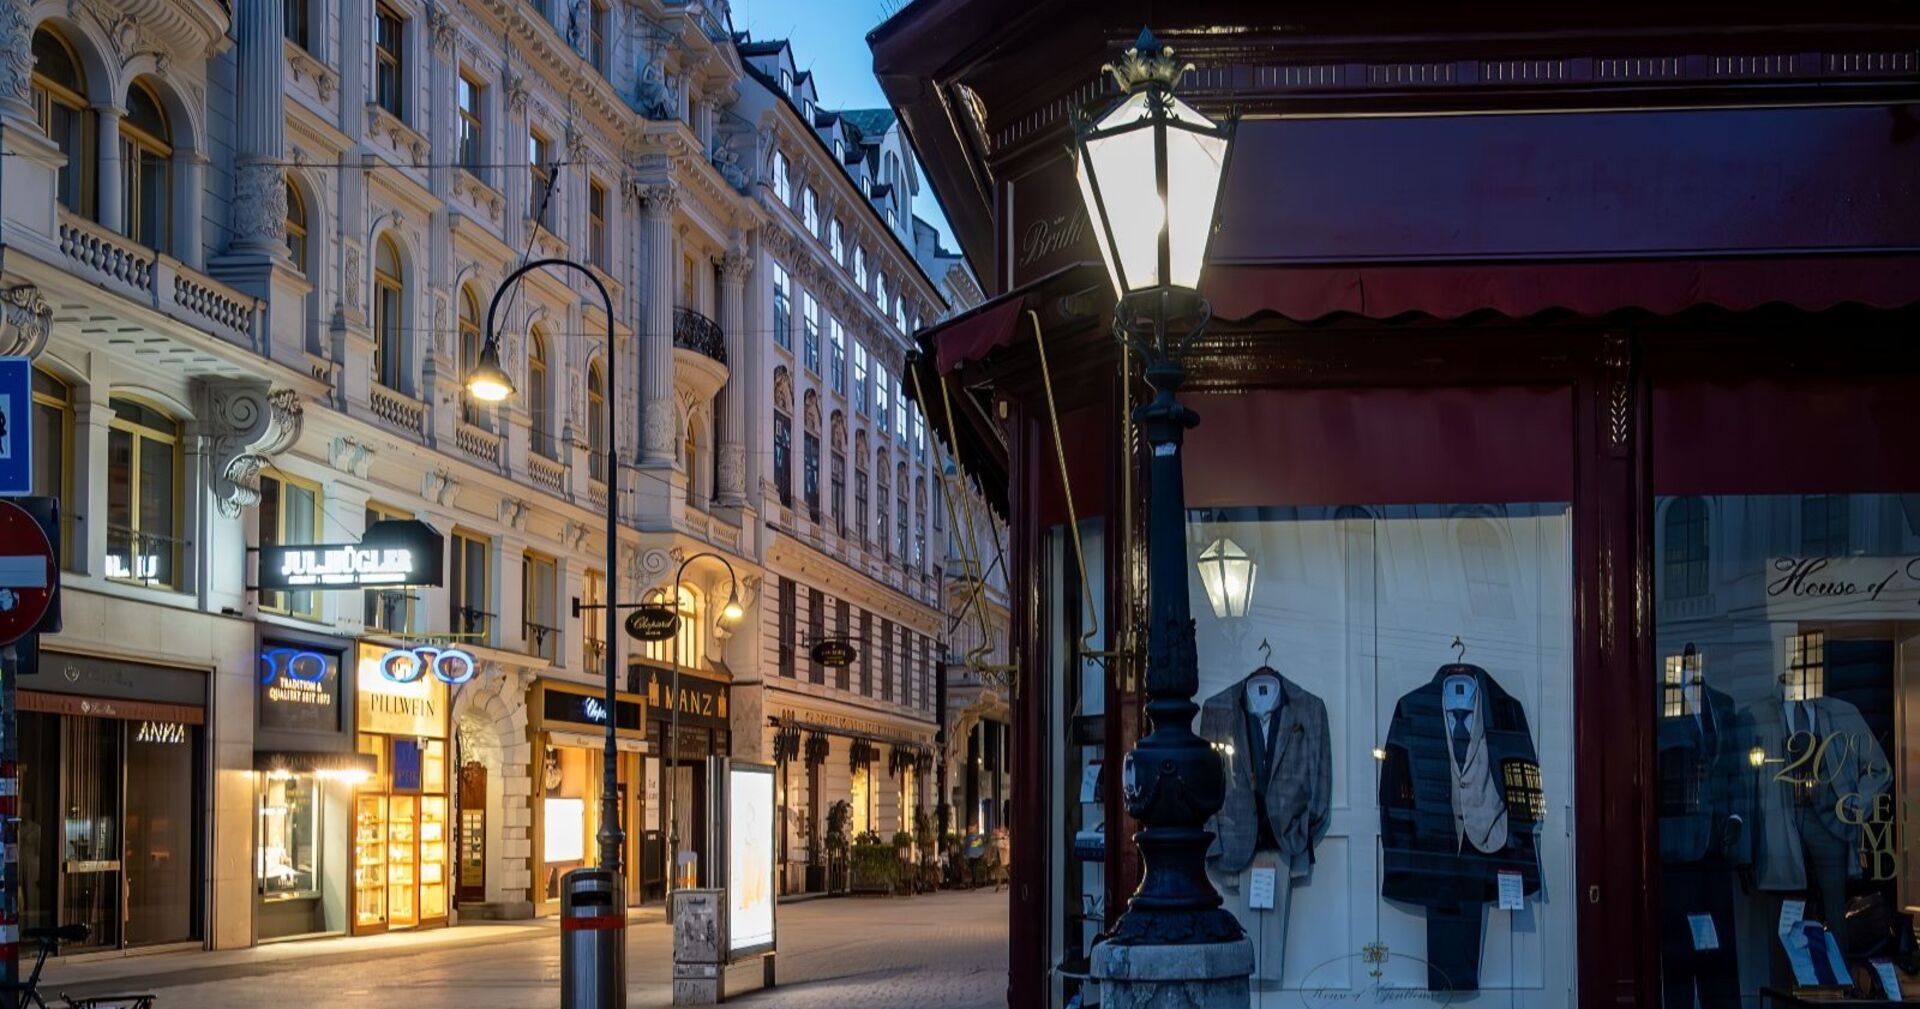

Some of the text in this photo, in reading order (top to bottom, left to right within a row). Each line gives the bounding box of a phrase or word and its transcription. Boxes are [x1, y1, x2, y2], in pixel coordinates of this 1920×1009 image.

[1767, 556, 1858, 597] House
[1867, 569, 1898, 601] of
[371, 692, 434, 717] PILLWEIN
